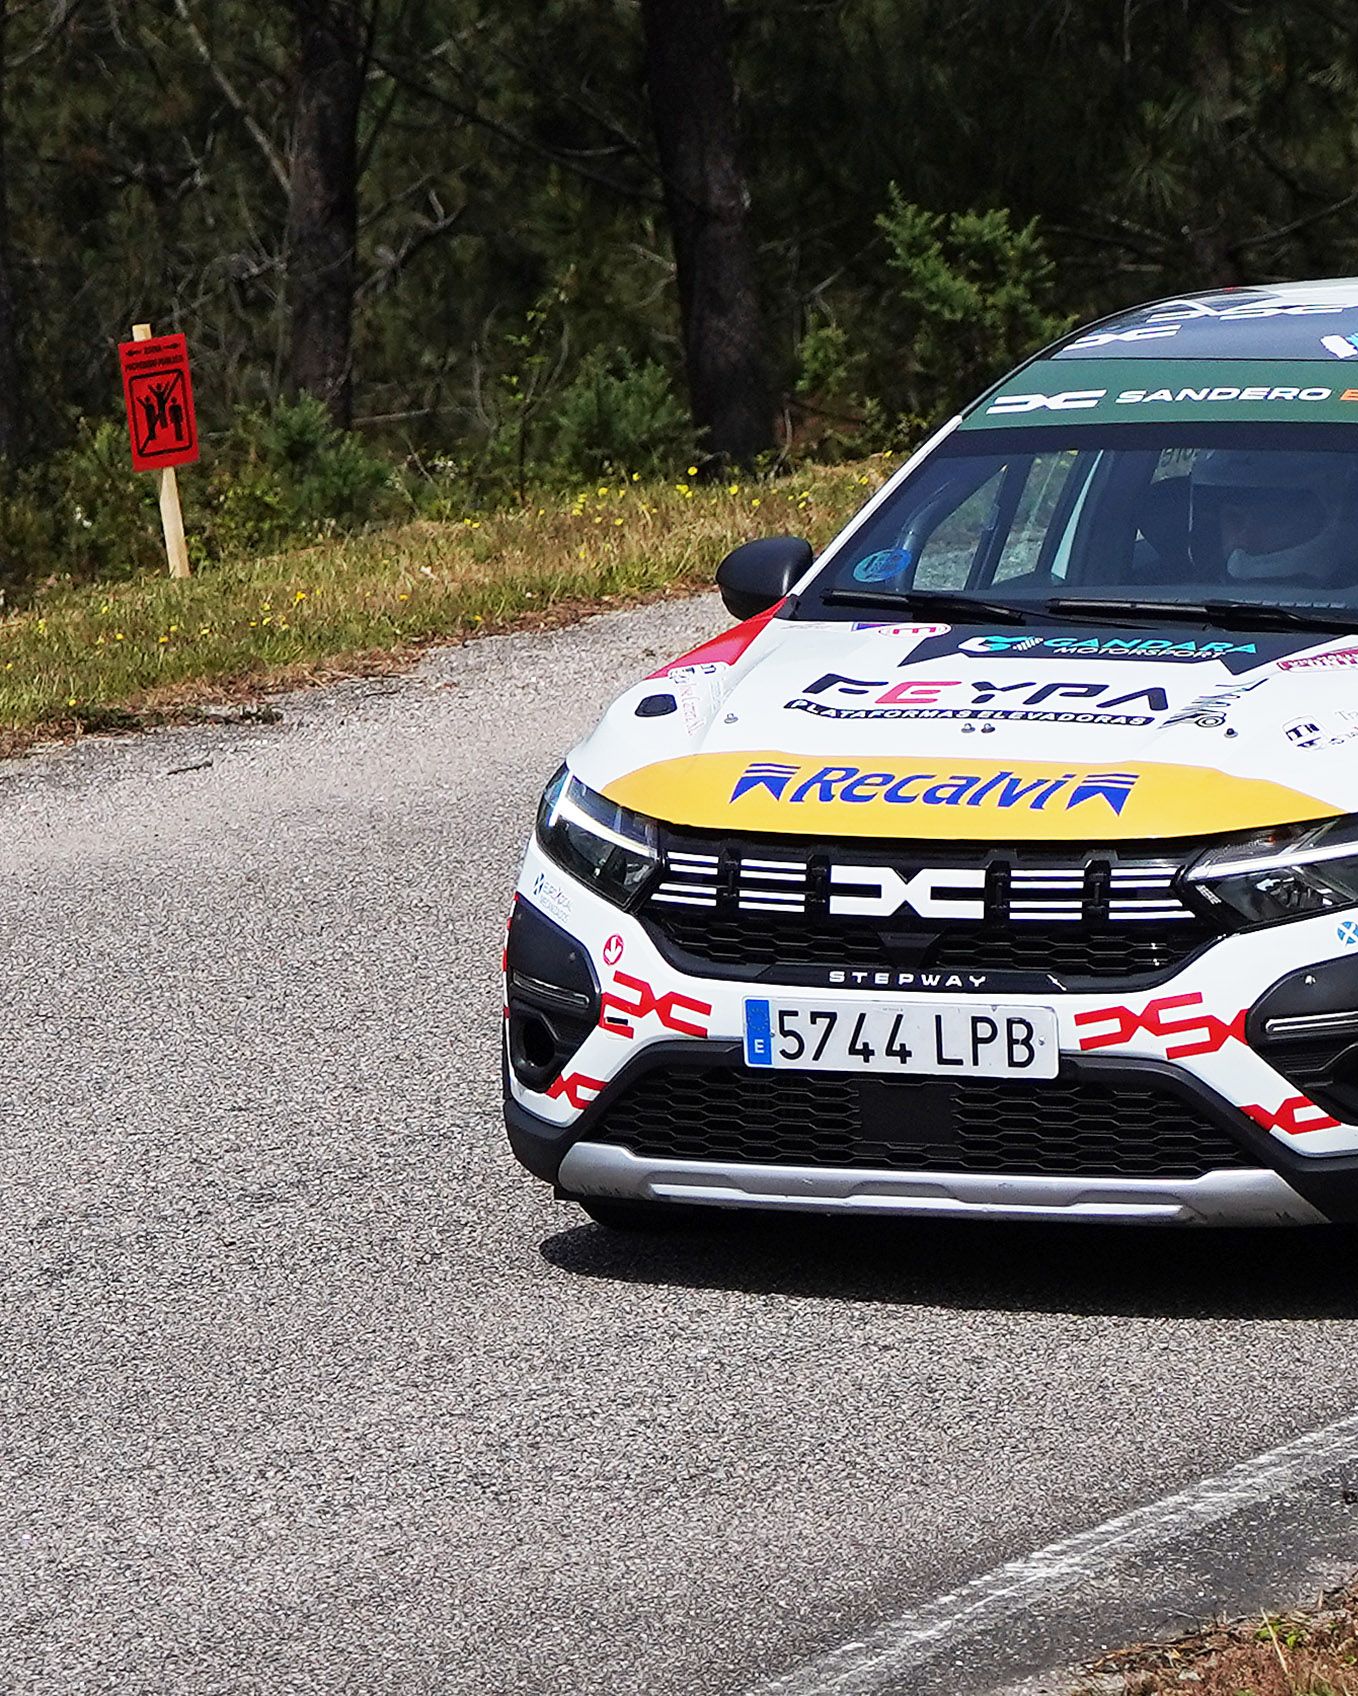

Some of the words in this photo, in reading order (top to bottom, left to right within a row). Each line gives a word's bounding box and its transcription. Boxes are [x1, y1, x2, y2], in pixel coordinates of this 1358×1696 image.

[1114, 386, 1333, 404] SANDERO
[1043, 637, 1257, 655] GANDARA
[1053, 646, 1227, 659] MOTORSPORT
[802, 672, 1169, 712] FEYPA
[788, 698, 971, 720] PLATAFORMAS
[978, 708, 1150, 726] ELEVADORAS
[788, 766, 1078, 811] Recalvi
[828, 970, 987, 988] STEPWAY
[753, 1039, 765, 1054] E
[778, 1010, 913, 1065] 5744
[935, 1014, 1036, 1069] LPB
